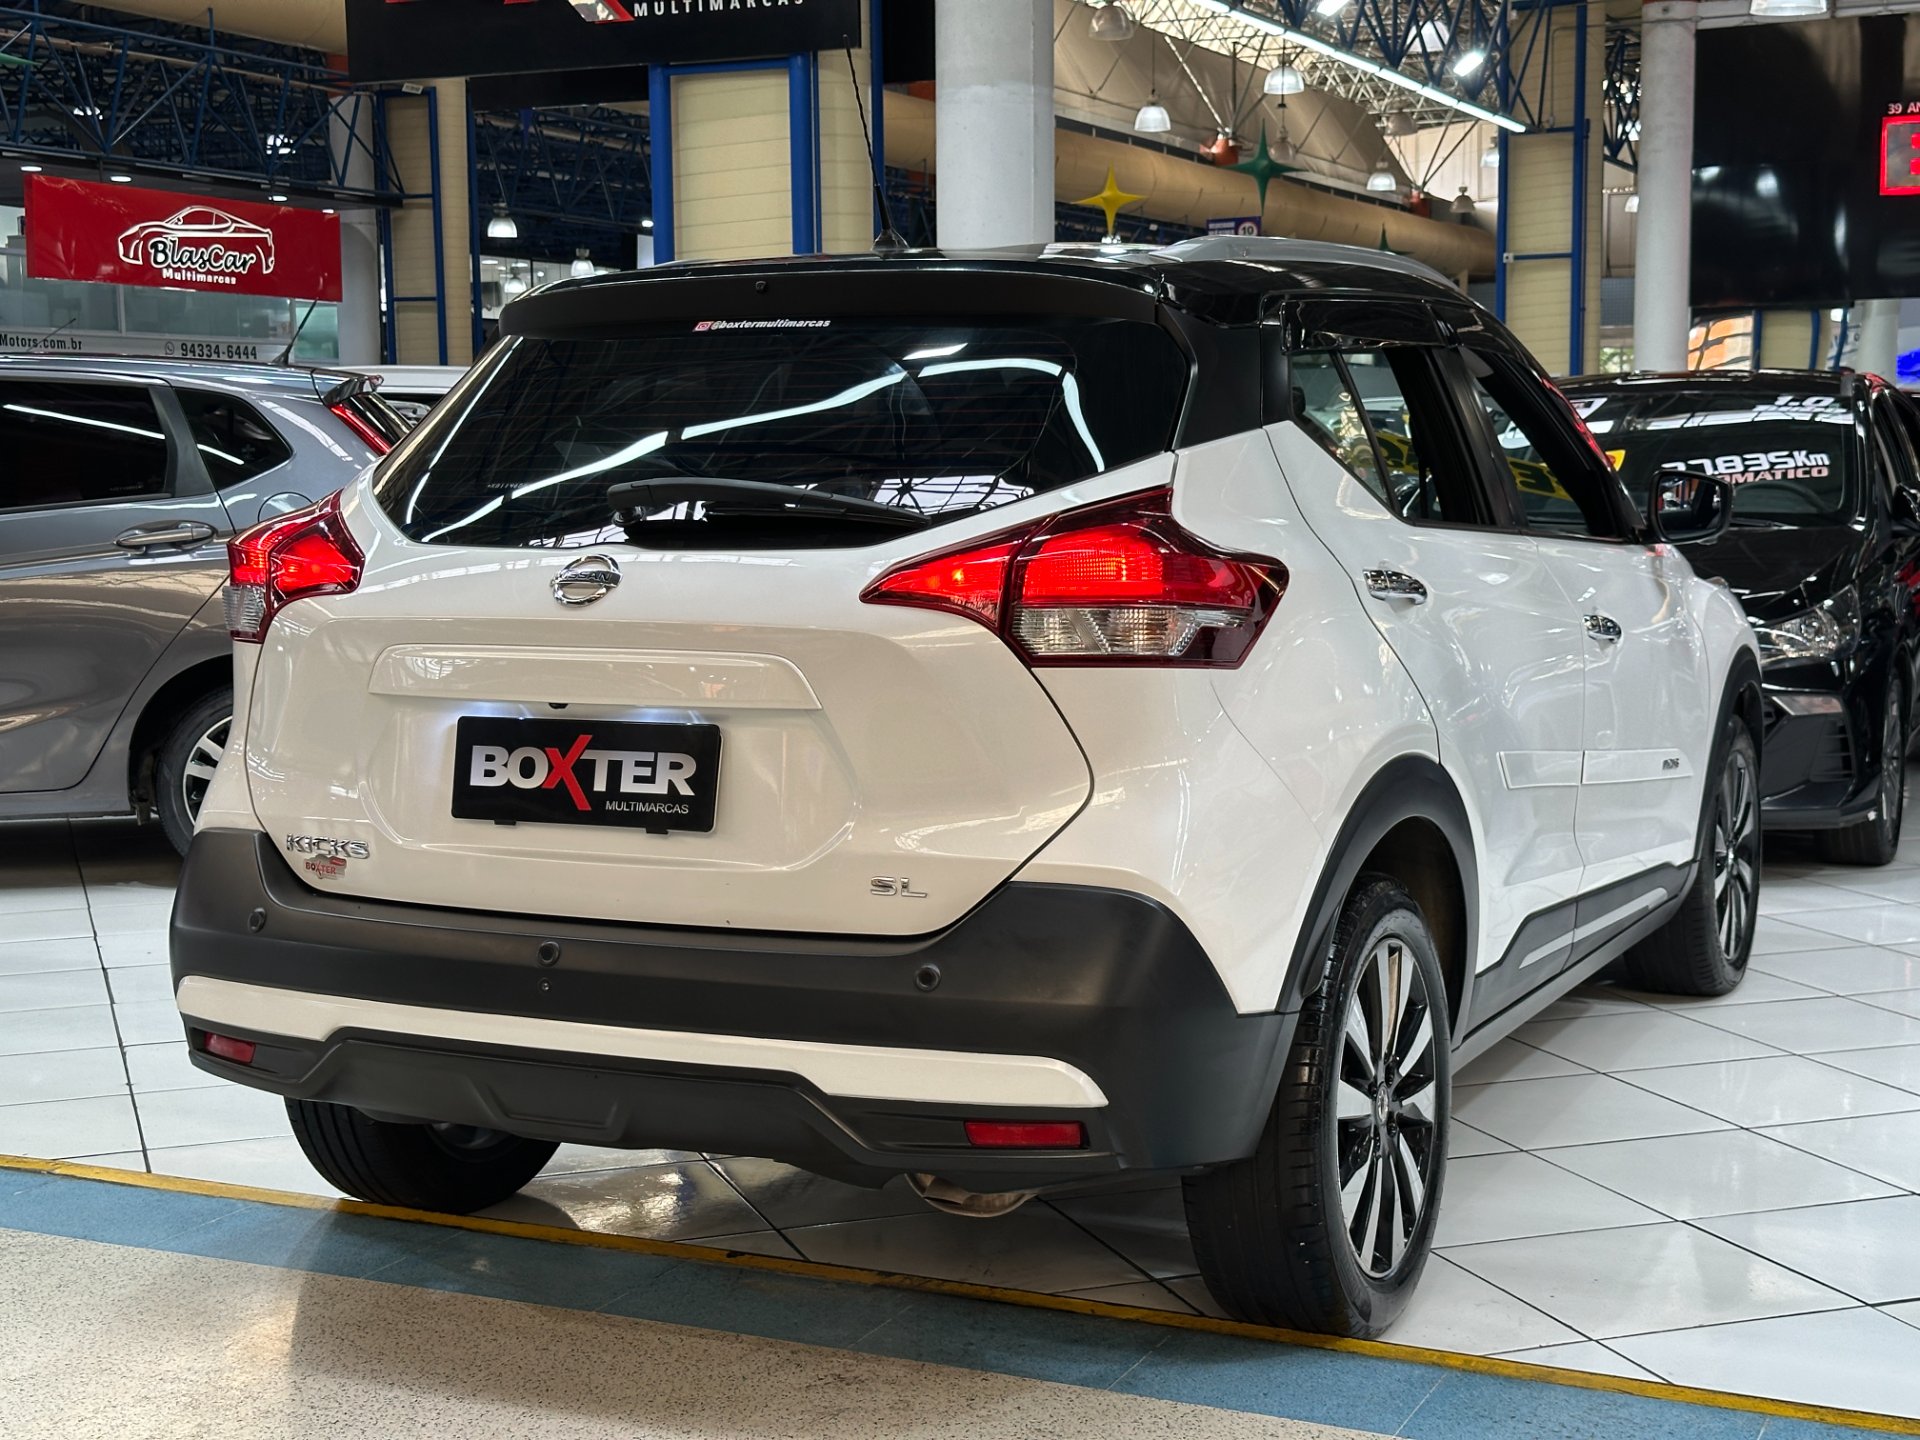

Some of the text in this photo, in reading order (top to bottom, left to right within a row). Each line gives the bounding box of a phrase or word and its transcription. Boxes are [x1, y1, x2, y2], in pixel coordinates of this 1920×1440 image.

[1888, 103, 1902, 114] 39
[148, 237, 257, 275] BlasCar
[162, 268, 236, 284] Multimarcas
[711, 319, 830, 330] @boxtermultimarcas
[181, 343, 257, 360] 94334-6444
[469, 734, 697, 811] BOXTER
[605, 800, 689, 814] MULTIMARCAS
[286, 833, 370, 859] KICKS
[870, 876, 928, 898] SL
